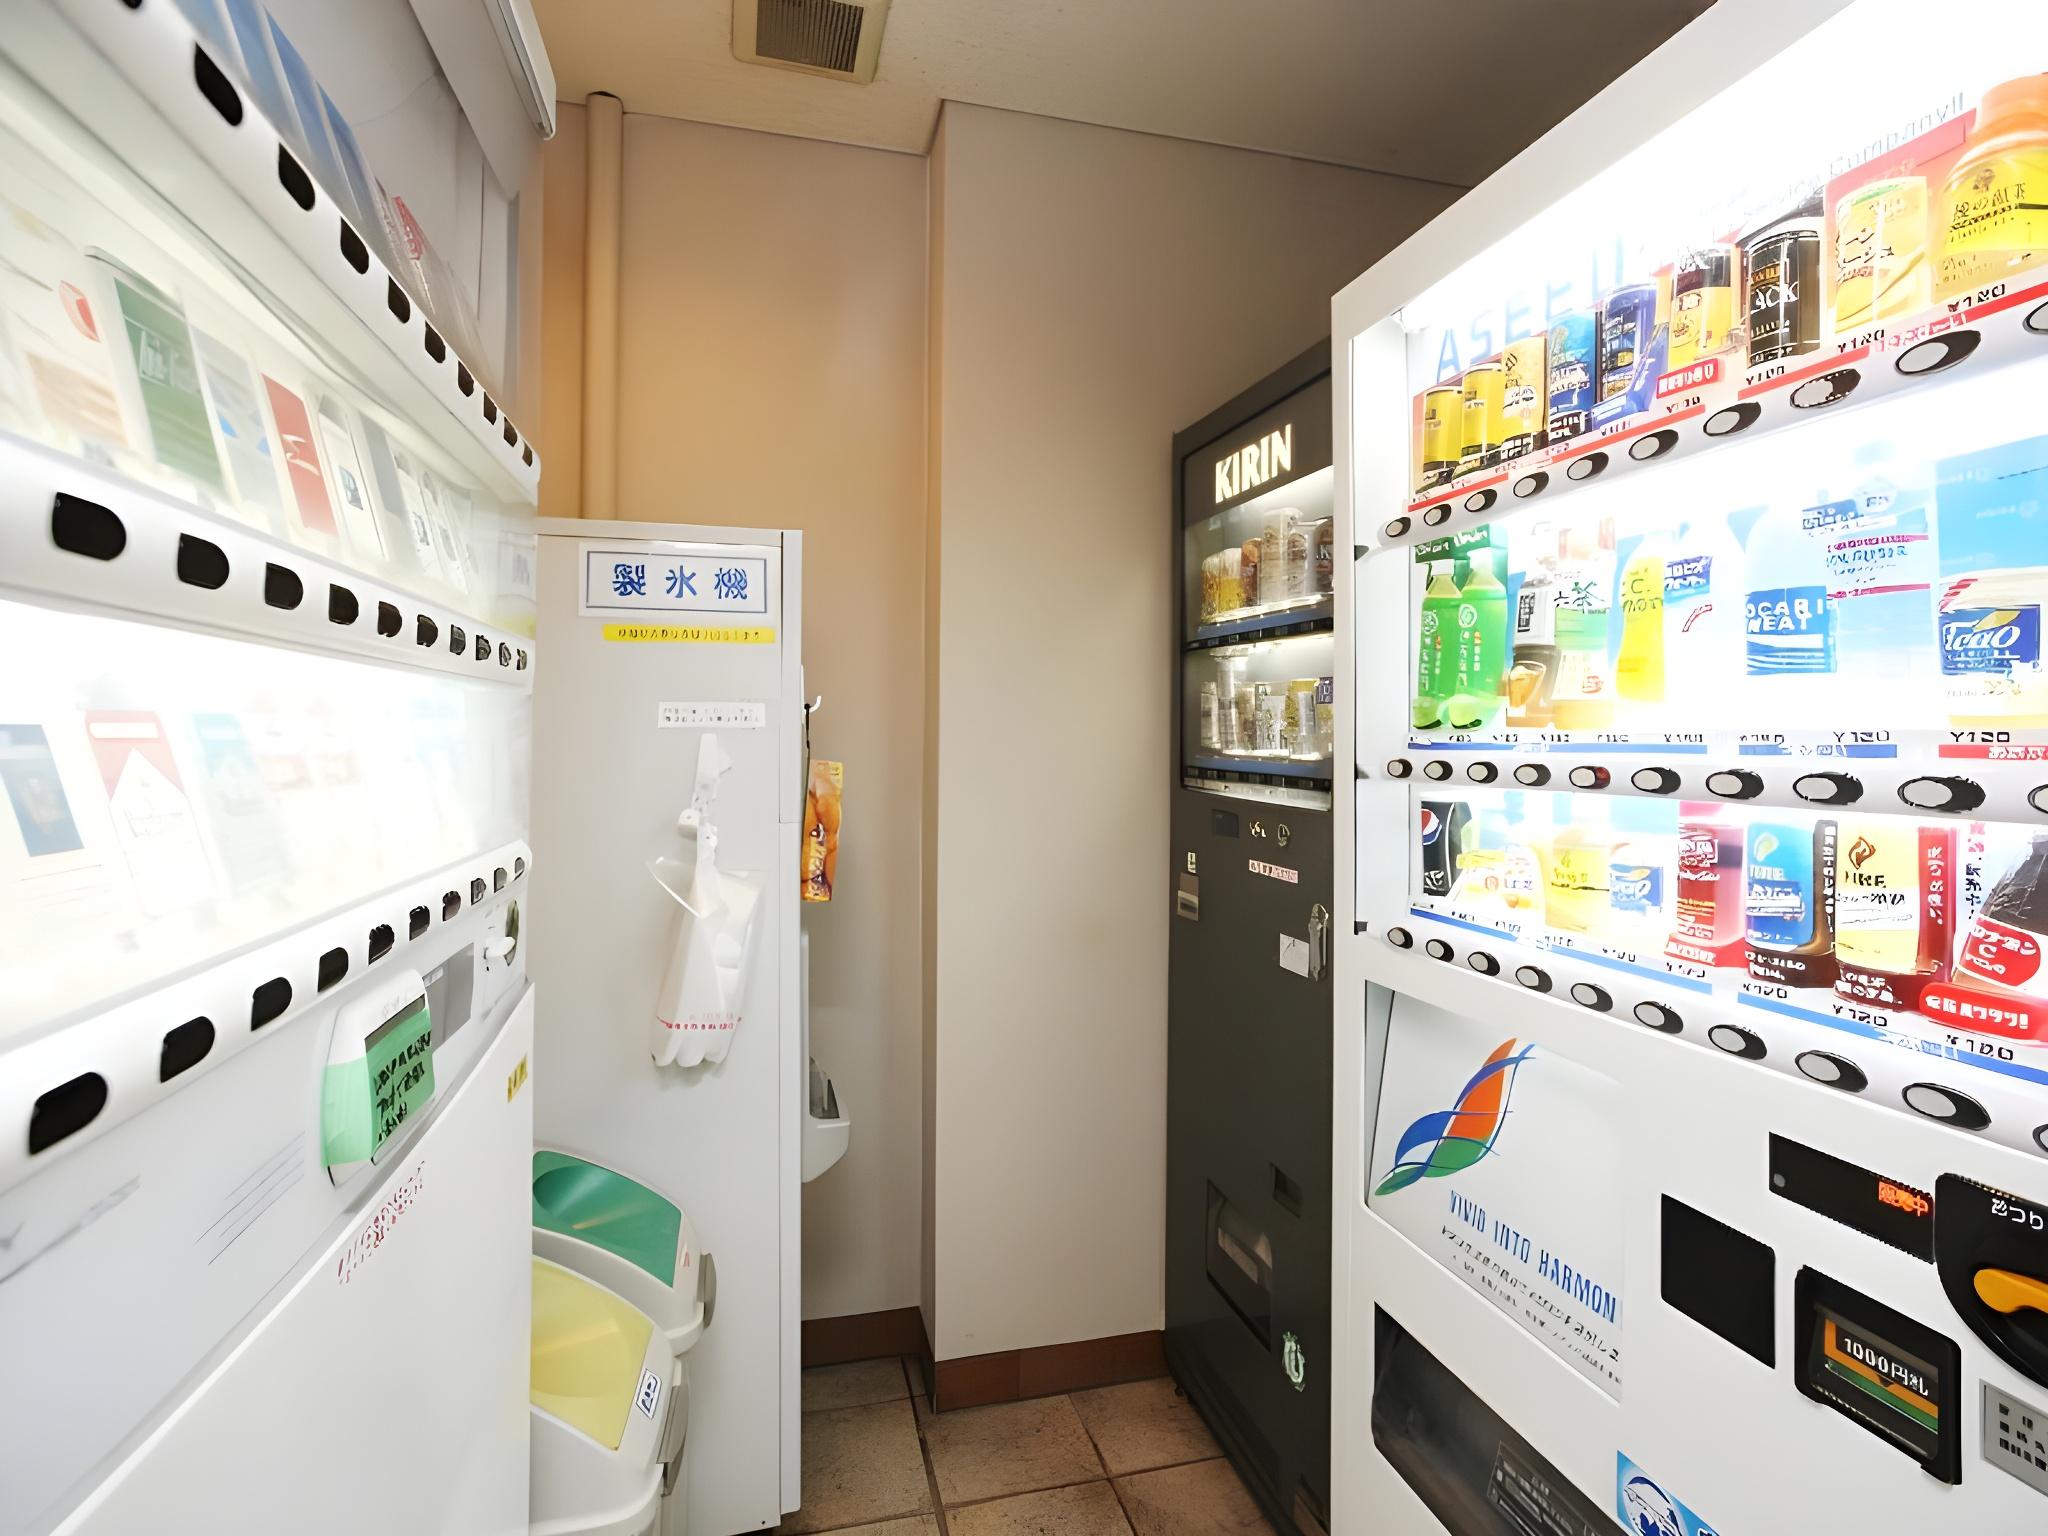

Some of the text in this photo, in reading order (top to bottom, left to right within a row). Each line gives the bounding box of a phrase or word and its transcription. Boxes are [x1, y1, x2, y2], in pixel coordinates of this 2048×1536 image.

[1215, 424, 1292, 504] KIRIN
[612, 563, 748, 600] 製氷機
